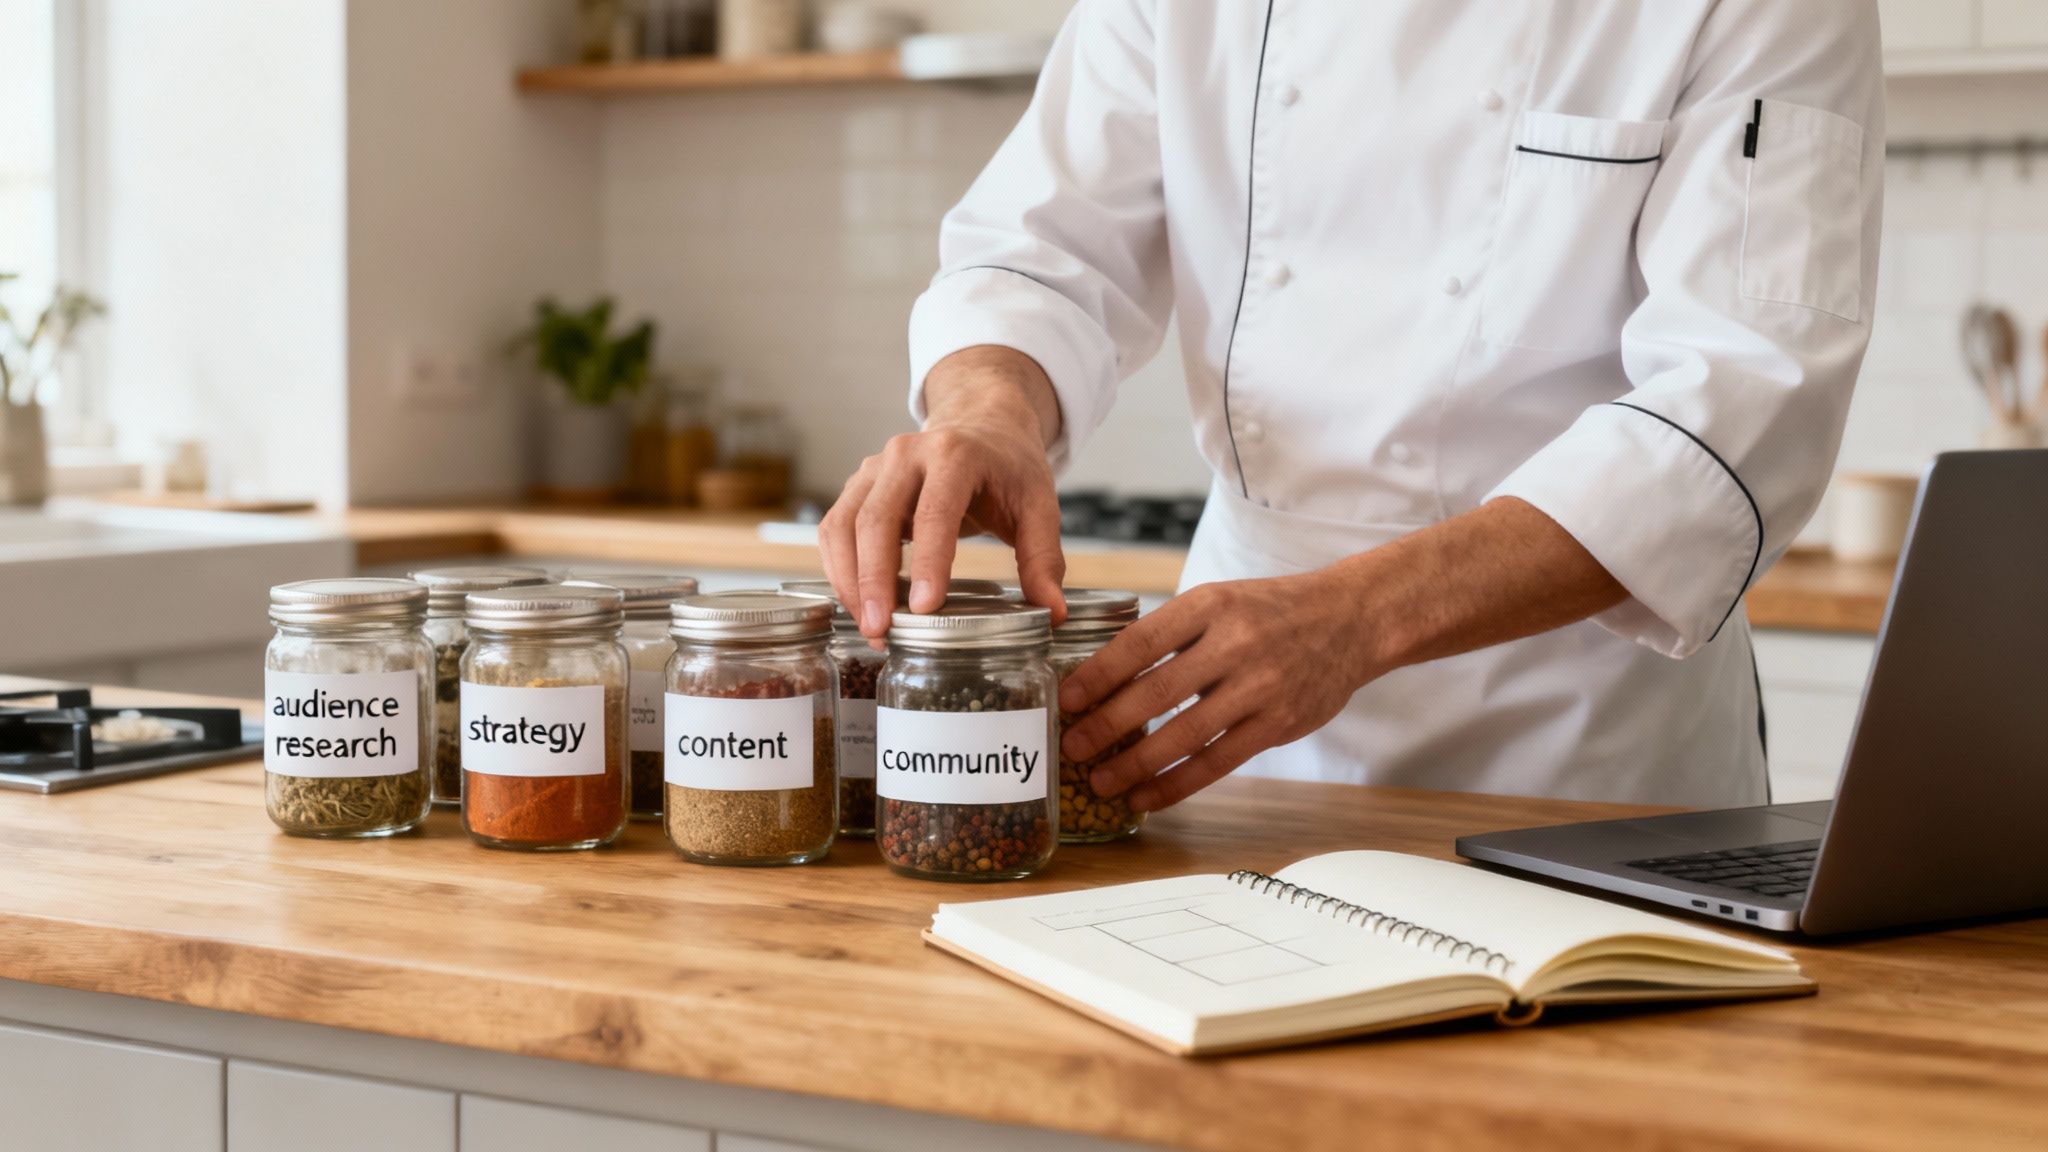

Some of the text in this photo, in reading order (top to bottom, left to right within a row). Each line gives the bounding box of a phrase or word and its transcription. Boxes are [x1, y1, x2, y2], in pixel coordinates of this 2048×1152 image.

[272, 688, 400, 719] audience
[276, 727, 397, 759] research
[468, 714, 586, 753] strategy
[678, 731, 789, 760] content
[882, 743, 1040, 784] community
